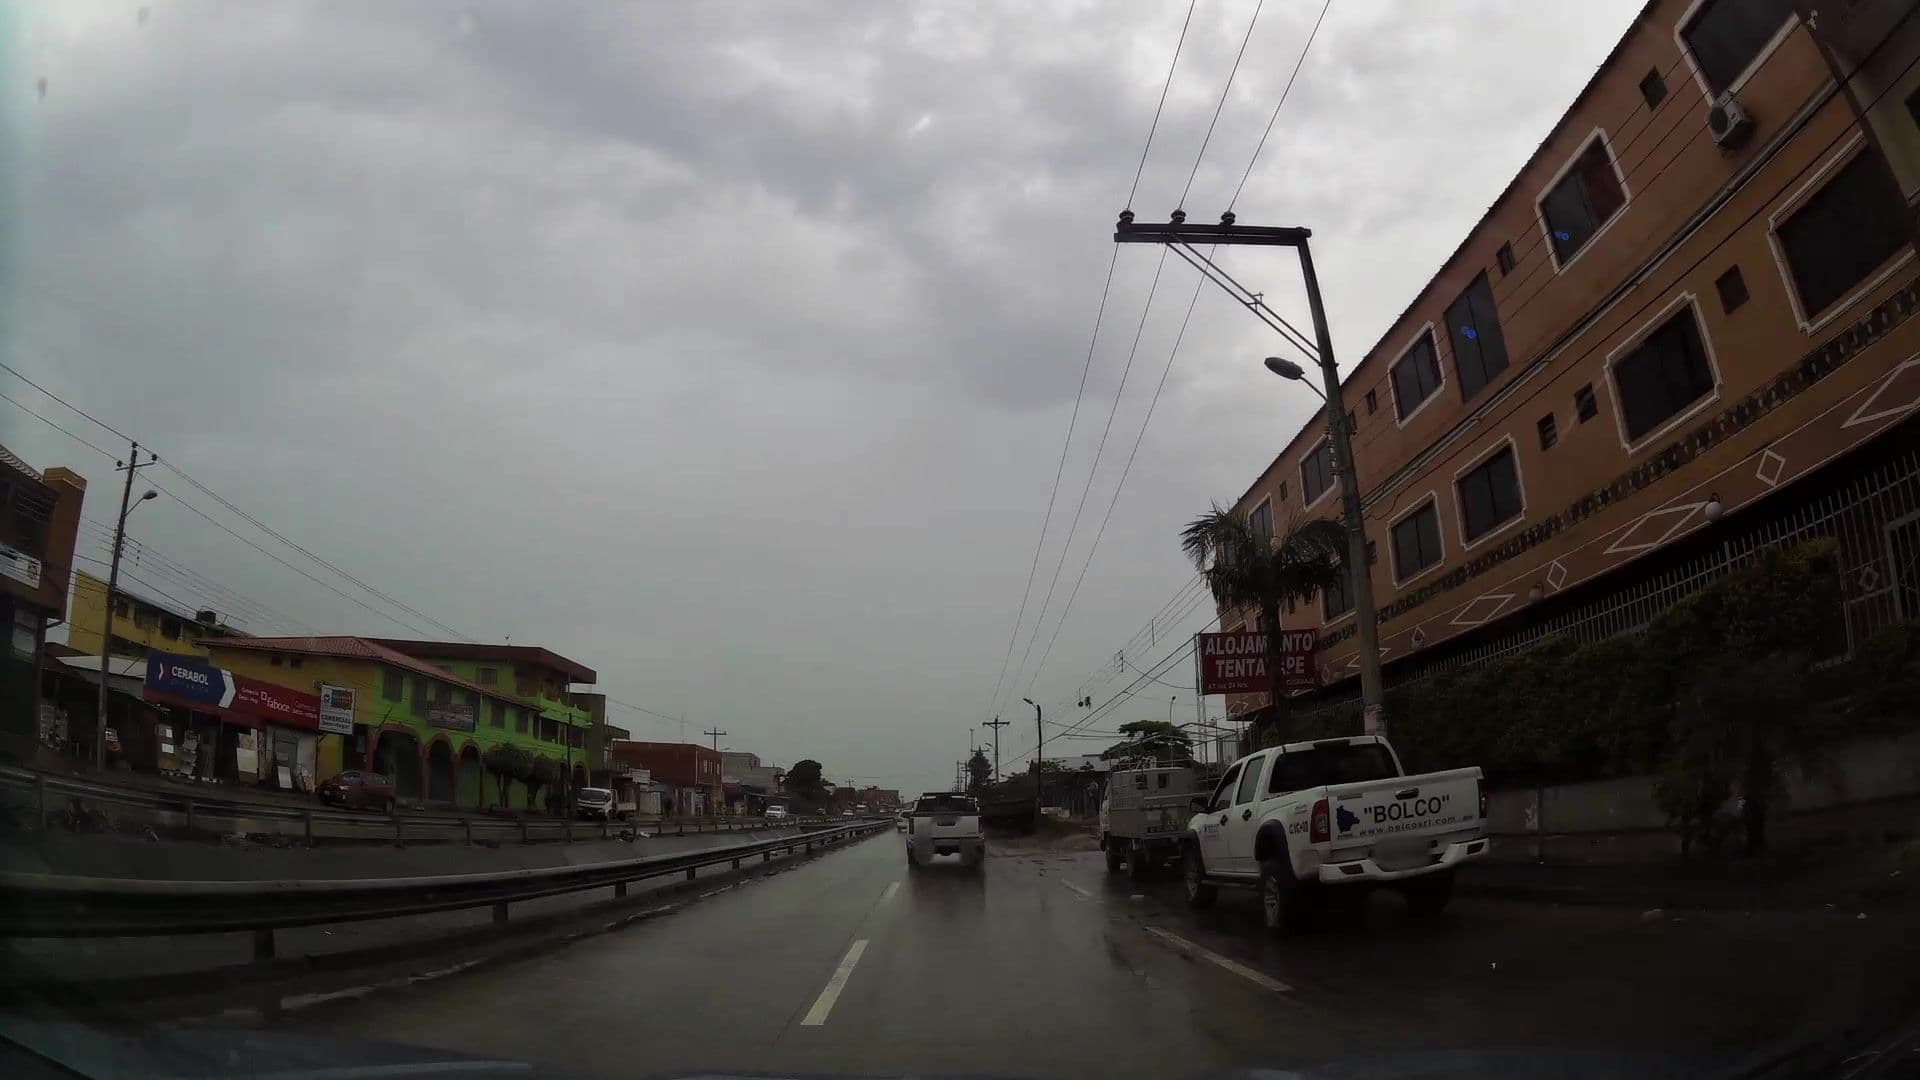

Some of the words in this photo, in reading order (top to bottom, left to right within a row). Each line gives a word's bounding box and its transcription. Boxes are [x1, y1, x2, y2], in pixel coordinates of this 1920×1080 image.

[1205, 633, 1313, 656] ALOJAMNTO
[171, 666, 209, 685] CERABOL
[1215, 656, 1305, 679] TENTAPE
[1364, 795, 1450, 824] "BOLCO"
